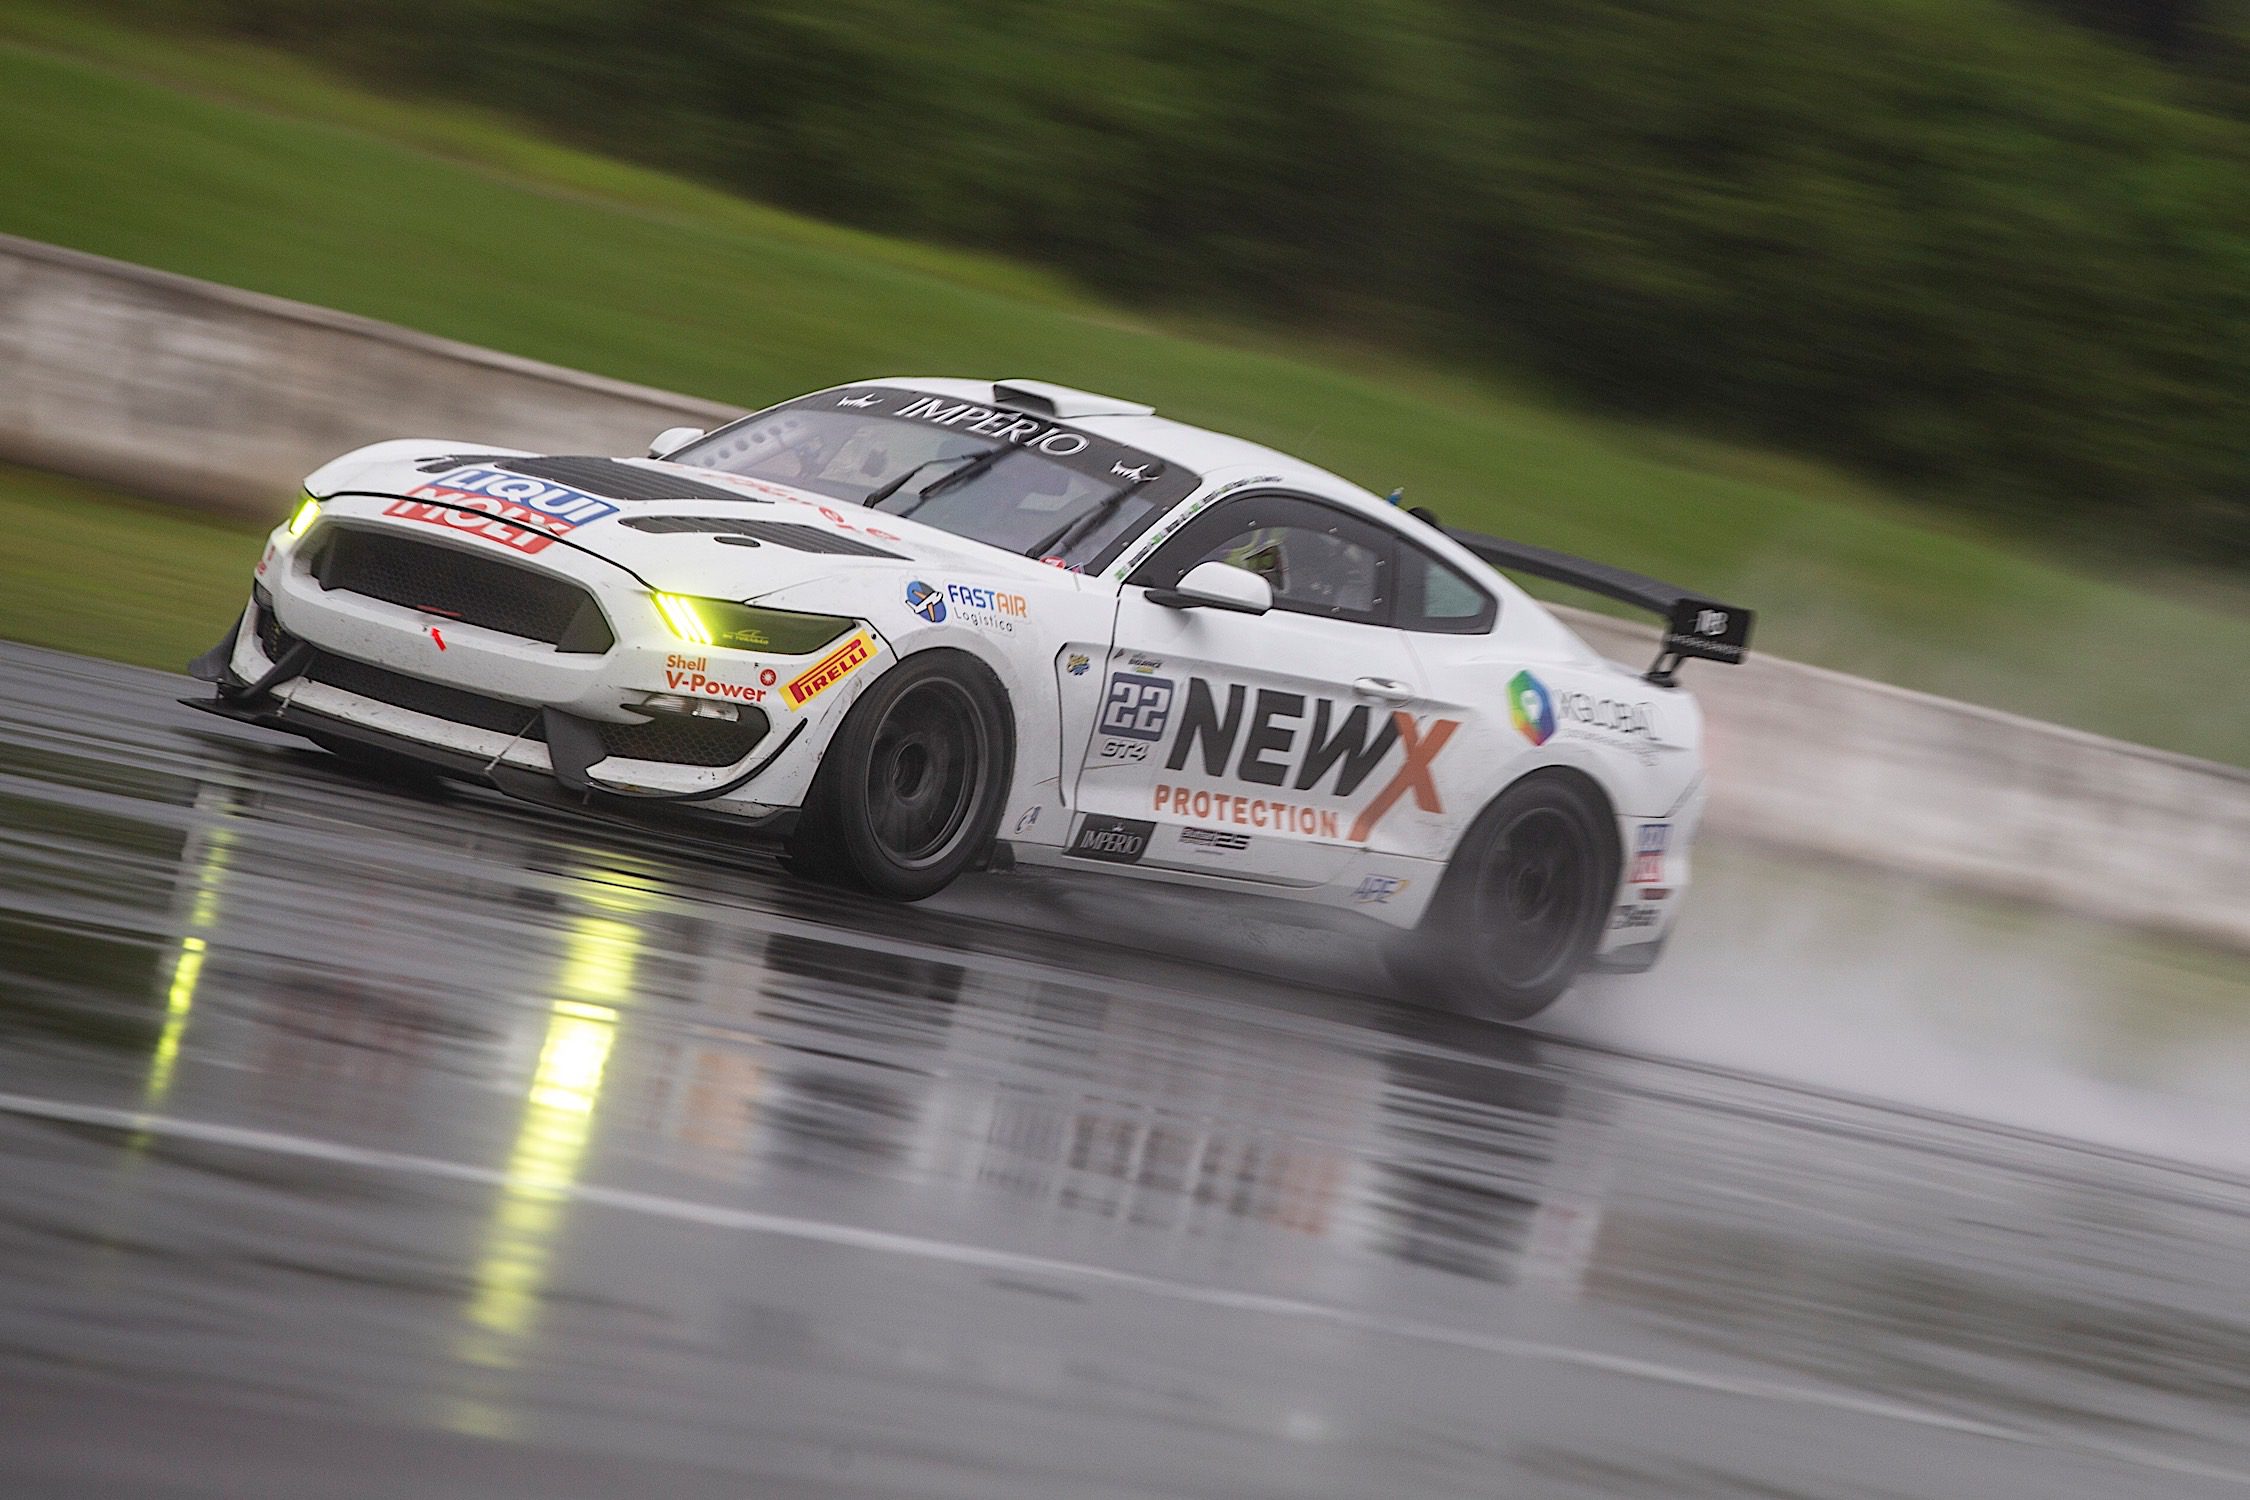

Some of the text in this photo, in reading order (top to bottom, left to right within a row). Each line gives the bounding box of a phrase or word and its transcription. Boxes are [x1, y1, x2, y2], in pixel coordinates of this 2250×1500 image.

[893, 397, 1089, 456] IMPERIO
[393, 487, 571, 547] MOLY
[438, 470, 610, 523] LIQUI
[666, 671, 766, 703] V-Power
[667, 654, 706, 672] Shell
[789, 639, 868, 704] PIRELLI
[1103, 681, 1171, 733] 22
[1100, 741, 1150, 761] GT4
[1153, 784, 1340, 839] PROTECTION
[1079, 829, 1144, 855] IMPERIO
